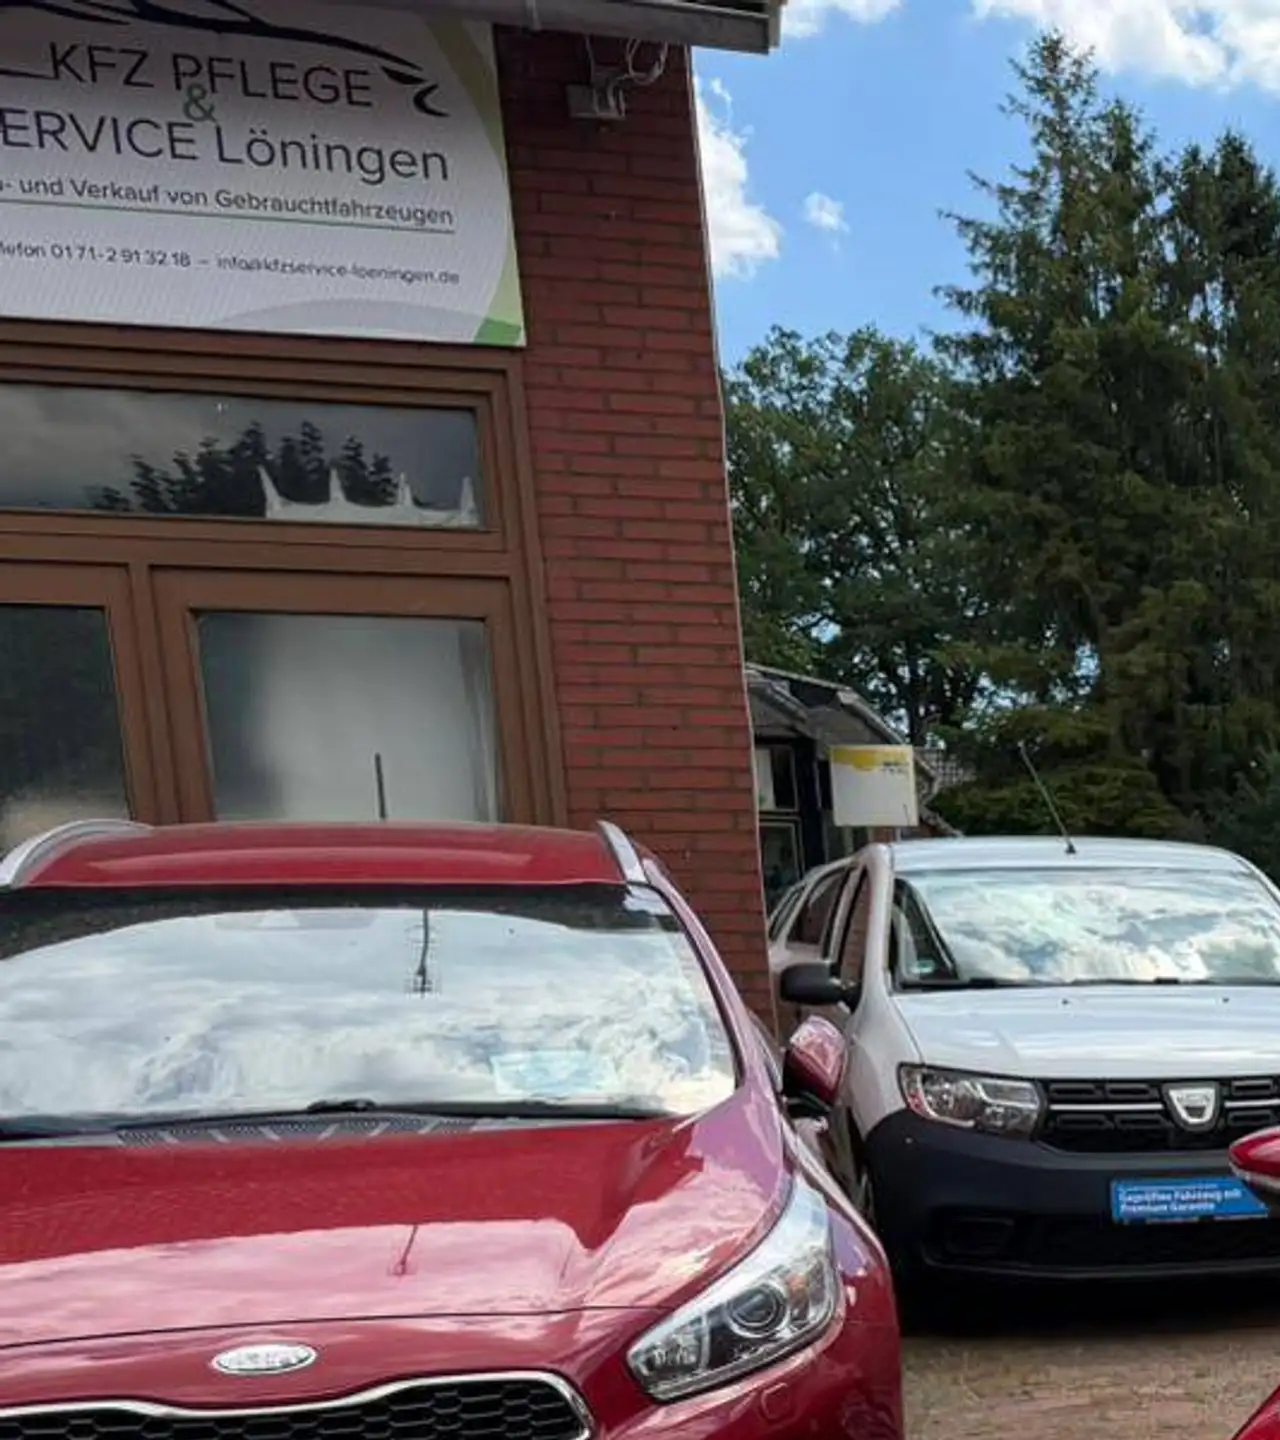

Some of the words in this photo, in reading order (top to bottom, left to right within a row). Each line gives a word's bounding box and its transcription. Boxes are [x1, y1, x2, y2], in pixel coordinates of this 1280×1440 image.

[50, 41, 154, 88] KFZ
[172, 53, 374, 108] PFLEGE
[183, 83, 219, 122] &
[0, 107, 199, 160] ERVICE
[216, 124, 449, 186] Löningen
[20, 178, 64, 197] und
[70, 178, 160, 203] Verkauf
[167, 190, 208, 207] von
[215, 188, 454, 226] Gebrauchtfahrzeugen
